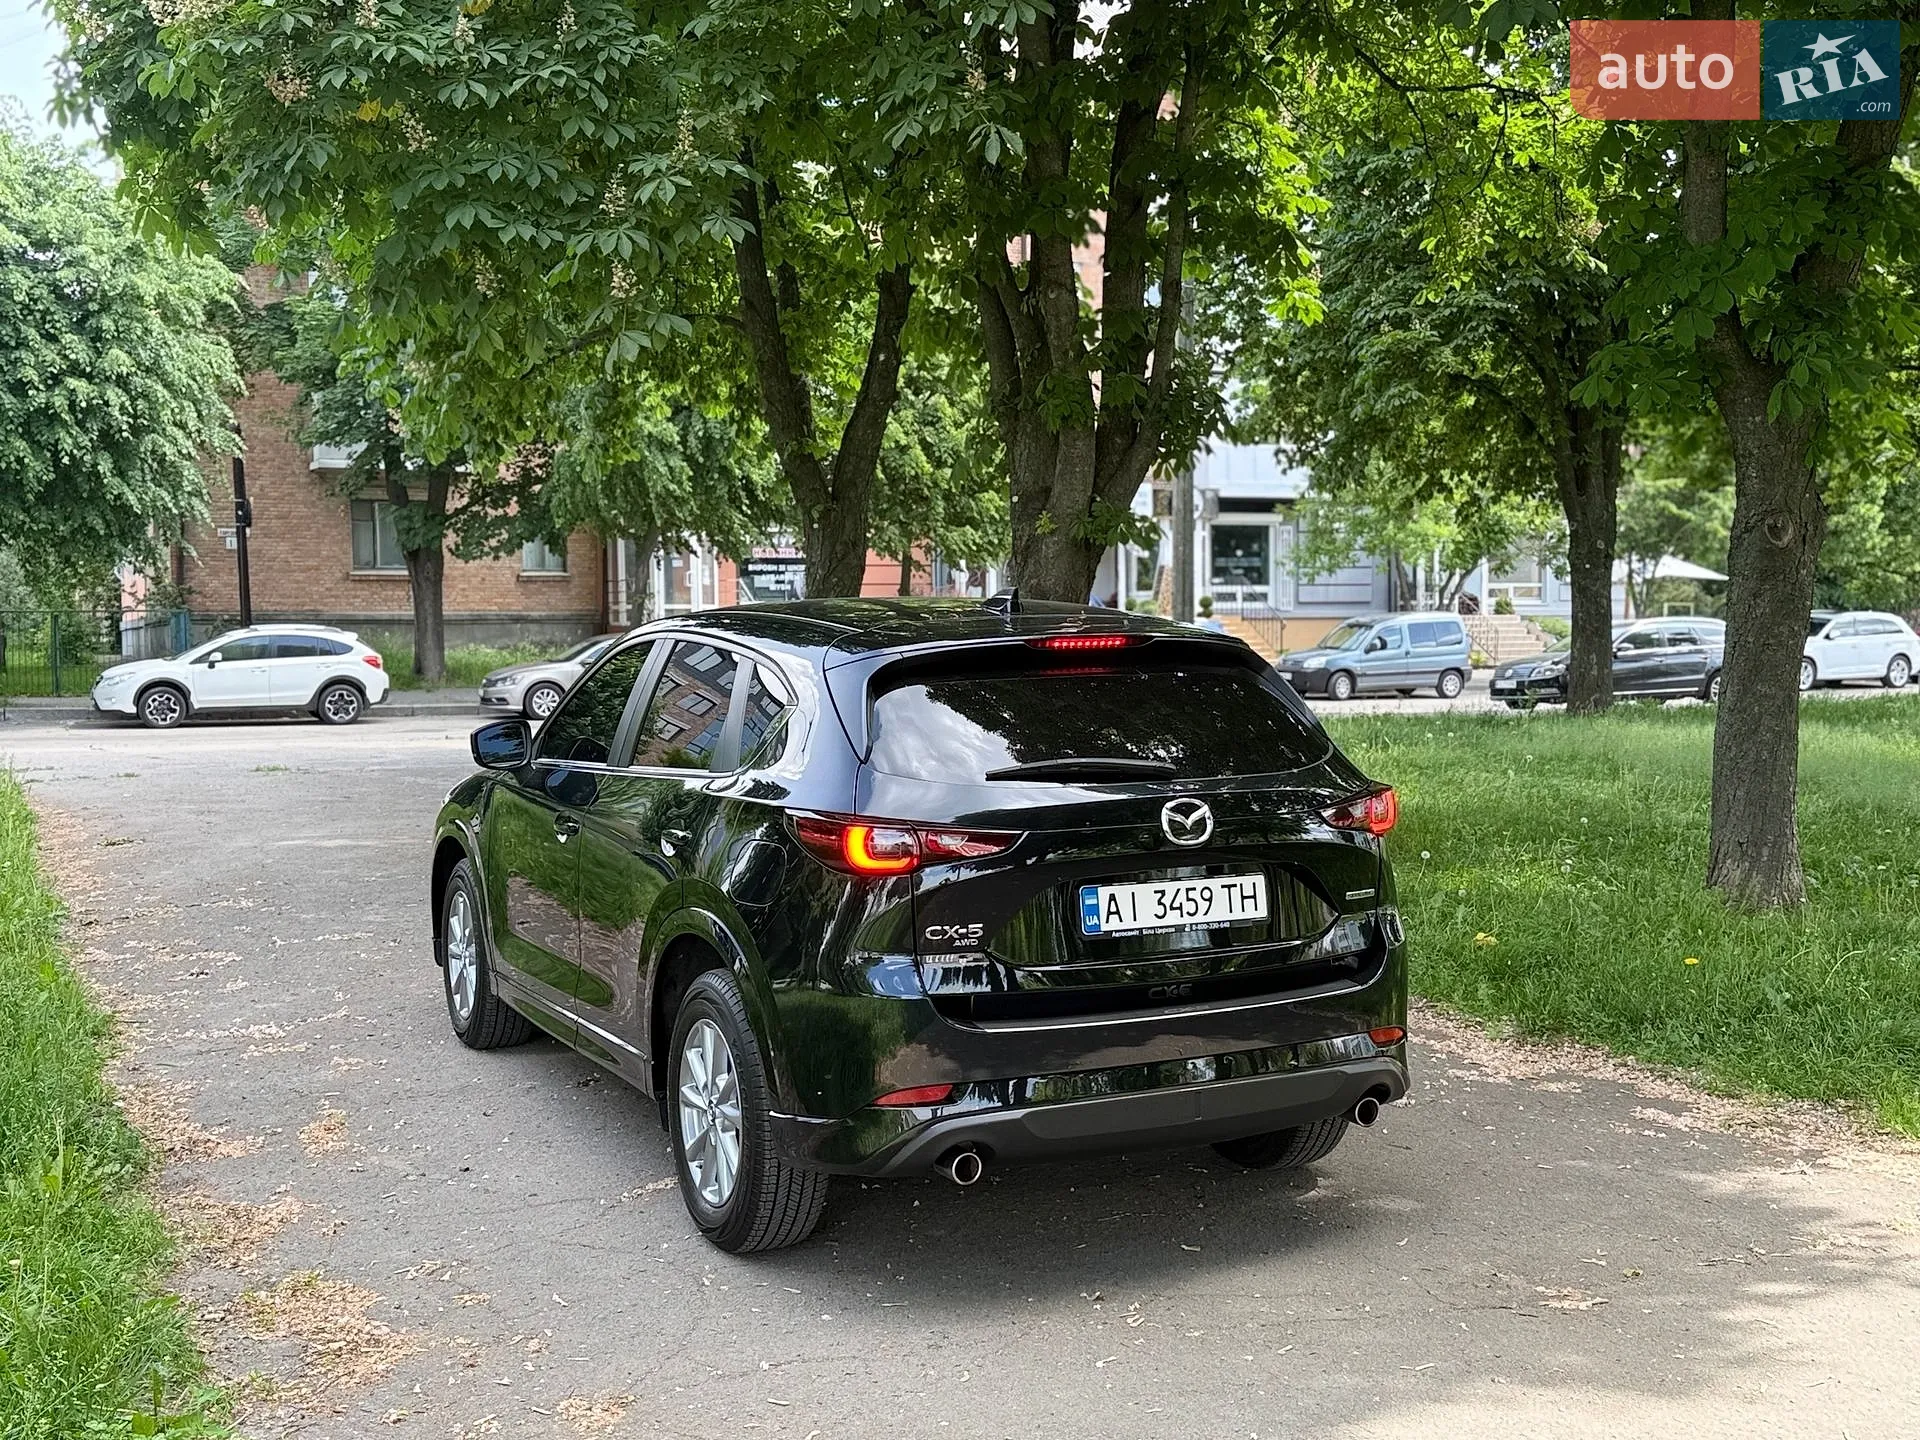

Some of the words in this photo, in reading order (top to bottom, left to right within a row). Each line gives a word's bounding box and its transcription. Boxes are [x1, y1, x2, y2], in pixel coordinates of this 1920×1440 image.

[1105, 891, 1137, 924] AI
[1153, 886, 1214, 920] 3459
[1220, 882, 1259, 914] TH
[1086, 915, 1100, 926] UA
[925, 923, 984, 940] CX-5
[953, 938, 979, 947] AWD
